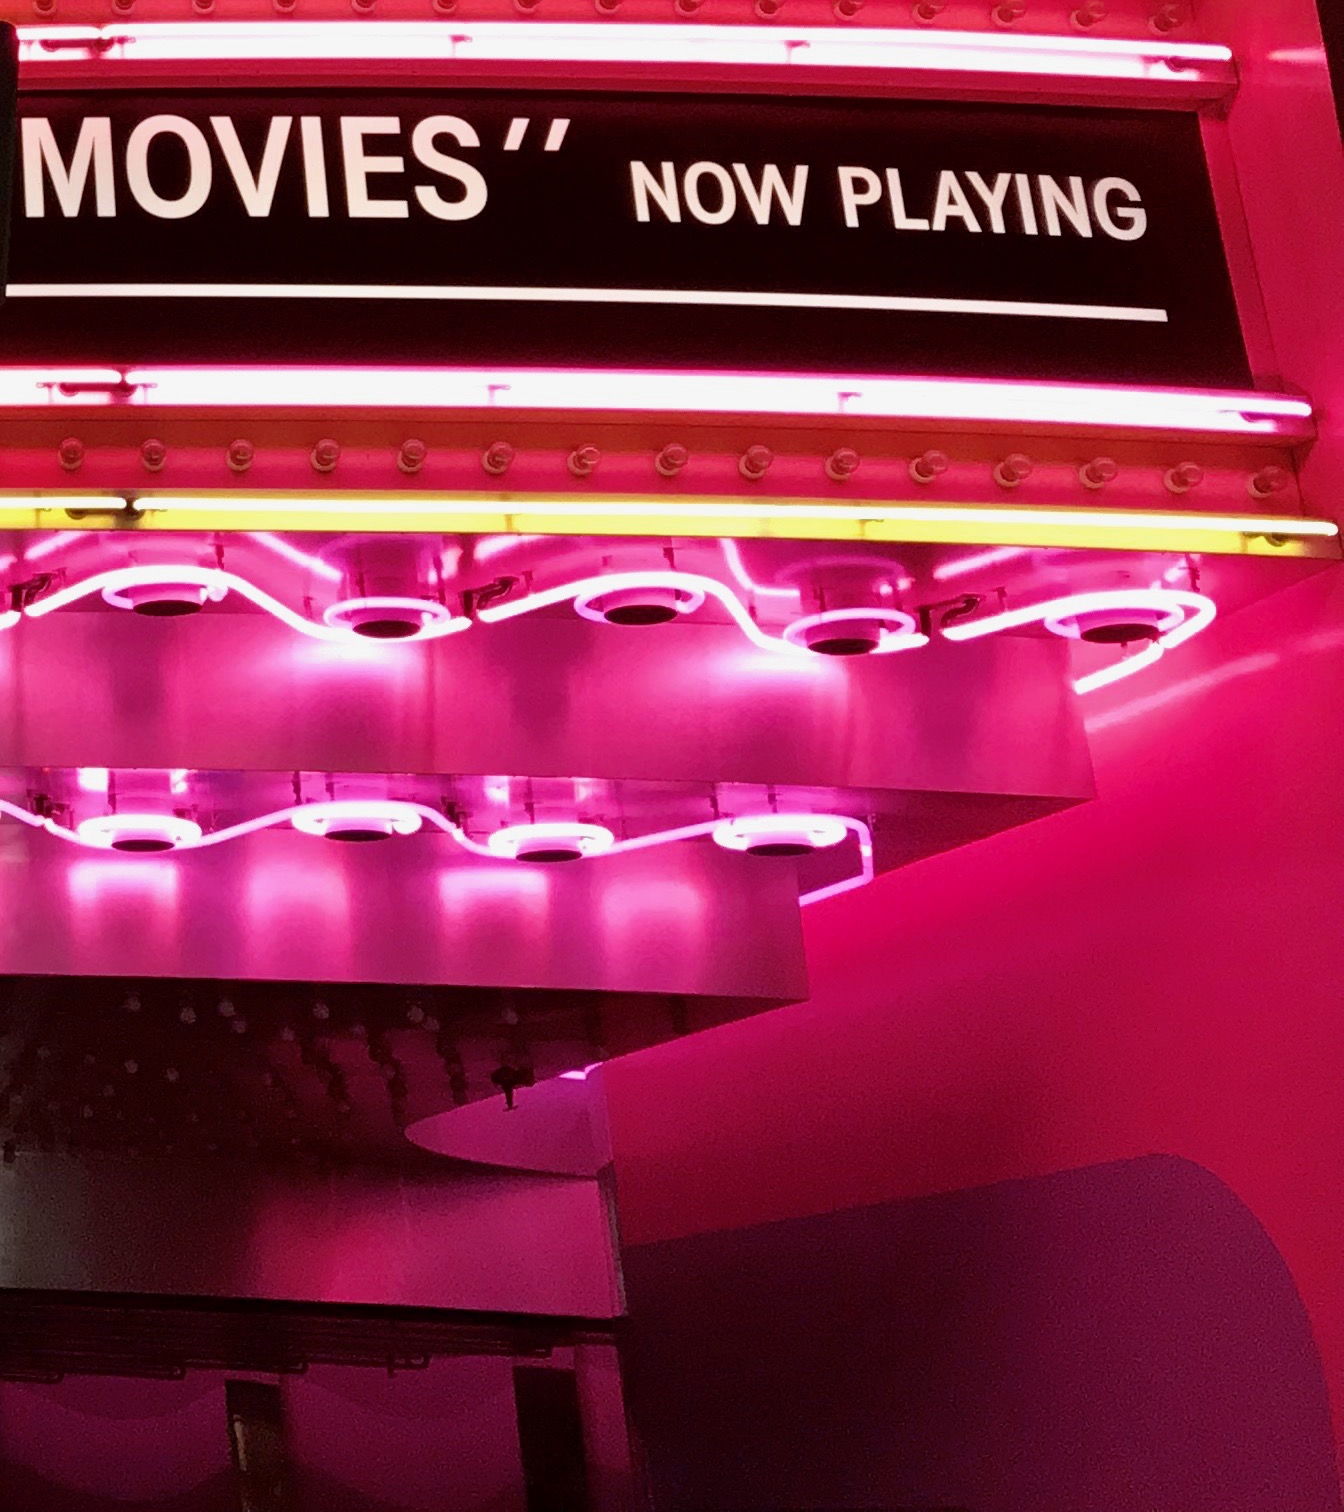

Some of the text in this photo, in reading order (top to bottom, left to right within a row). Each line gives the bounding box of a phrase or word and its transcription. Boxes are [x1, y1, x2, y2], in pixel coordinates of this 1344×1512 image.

[21, 114, 571, 221] MOVIES"
[630, 160, 1147, 241] NOW PLAYING
